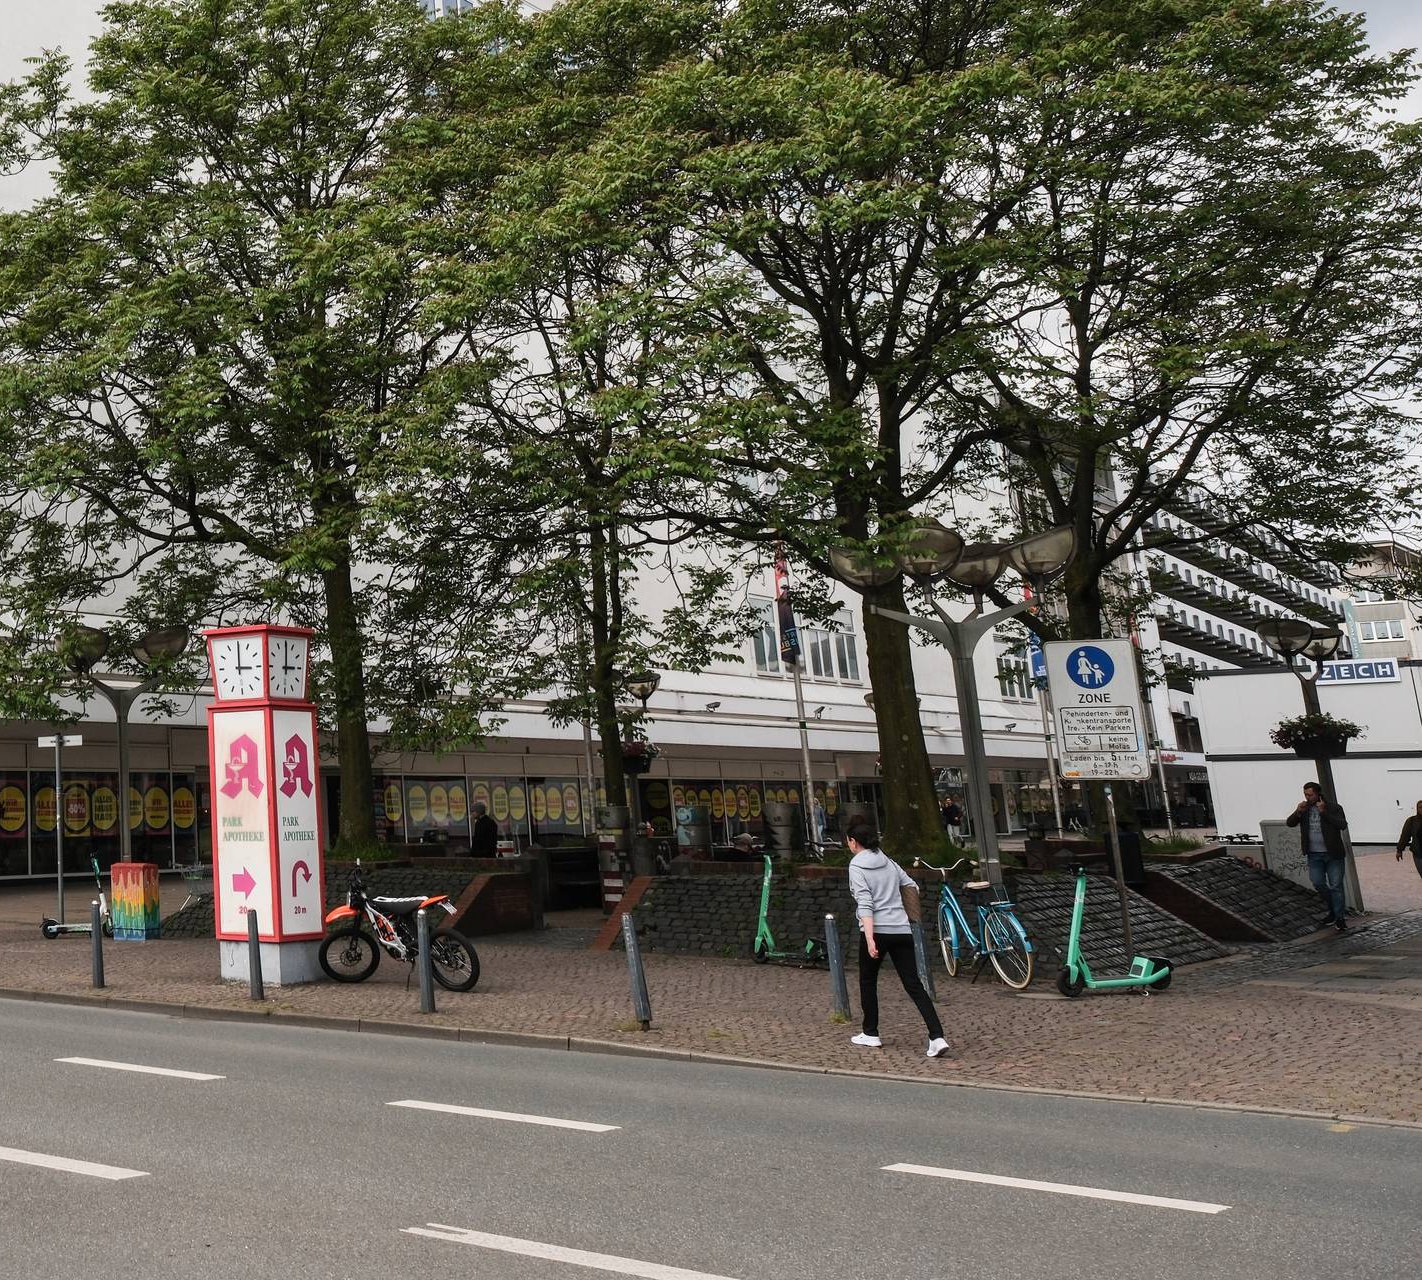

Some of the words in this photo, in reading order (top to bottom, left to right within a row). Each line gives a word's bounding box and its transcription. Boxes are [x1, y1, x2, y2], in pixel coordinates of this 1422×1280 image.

[1322, 665, 1392, 678] ZECH
[1078, 694, 1112, 703] ZONE
[222, 816, 242, 827] PARK
[282, 816, 299, 826] PARK
[224, 832, 265, 842] APOTHEKE
[283, 831, 315, 840] APOTHEKE
[239, 906, 248, 914] 20
[294, 906, 302, 914] 20
